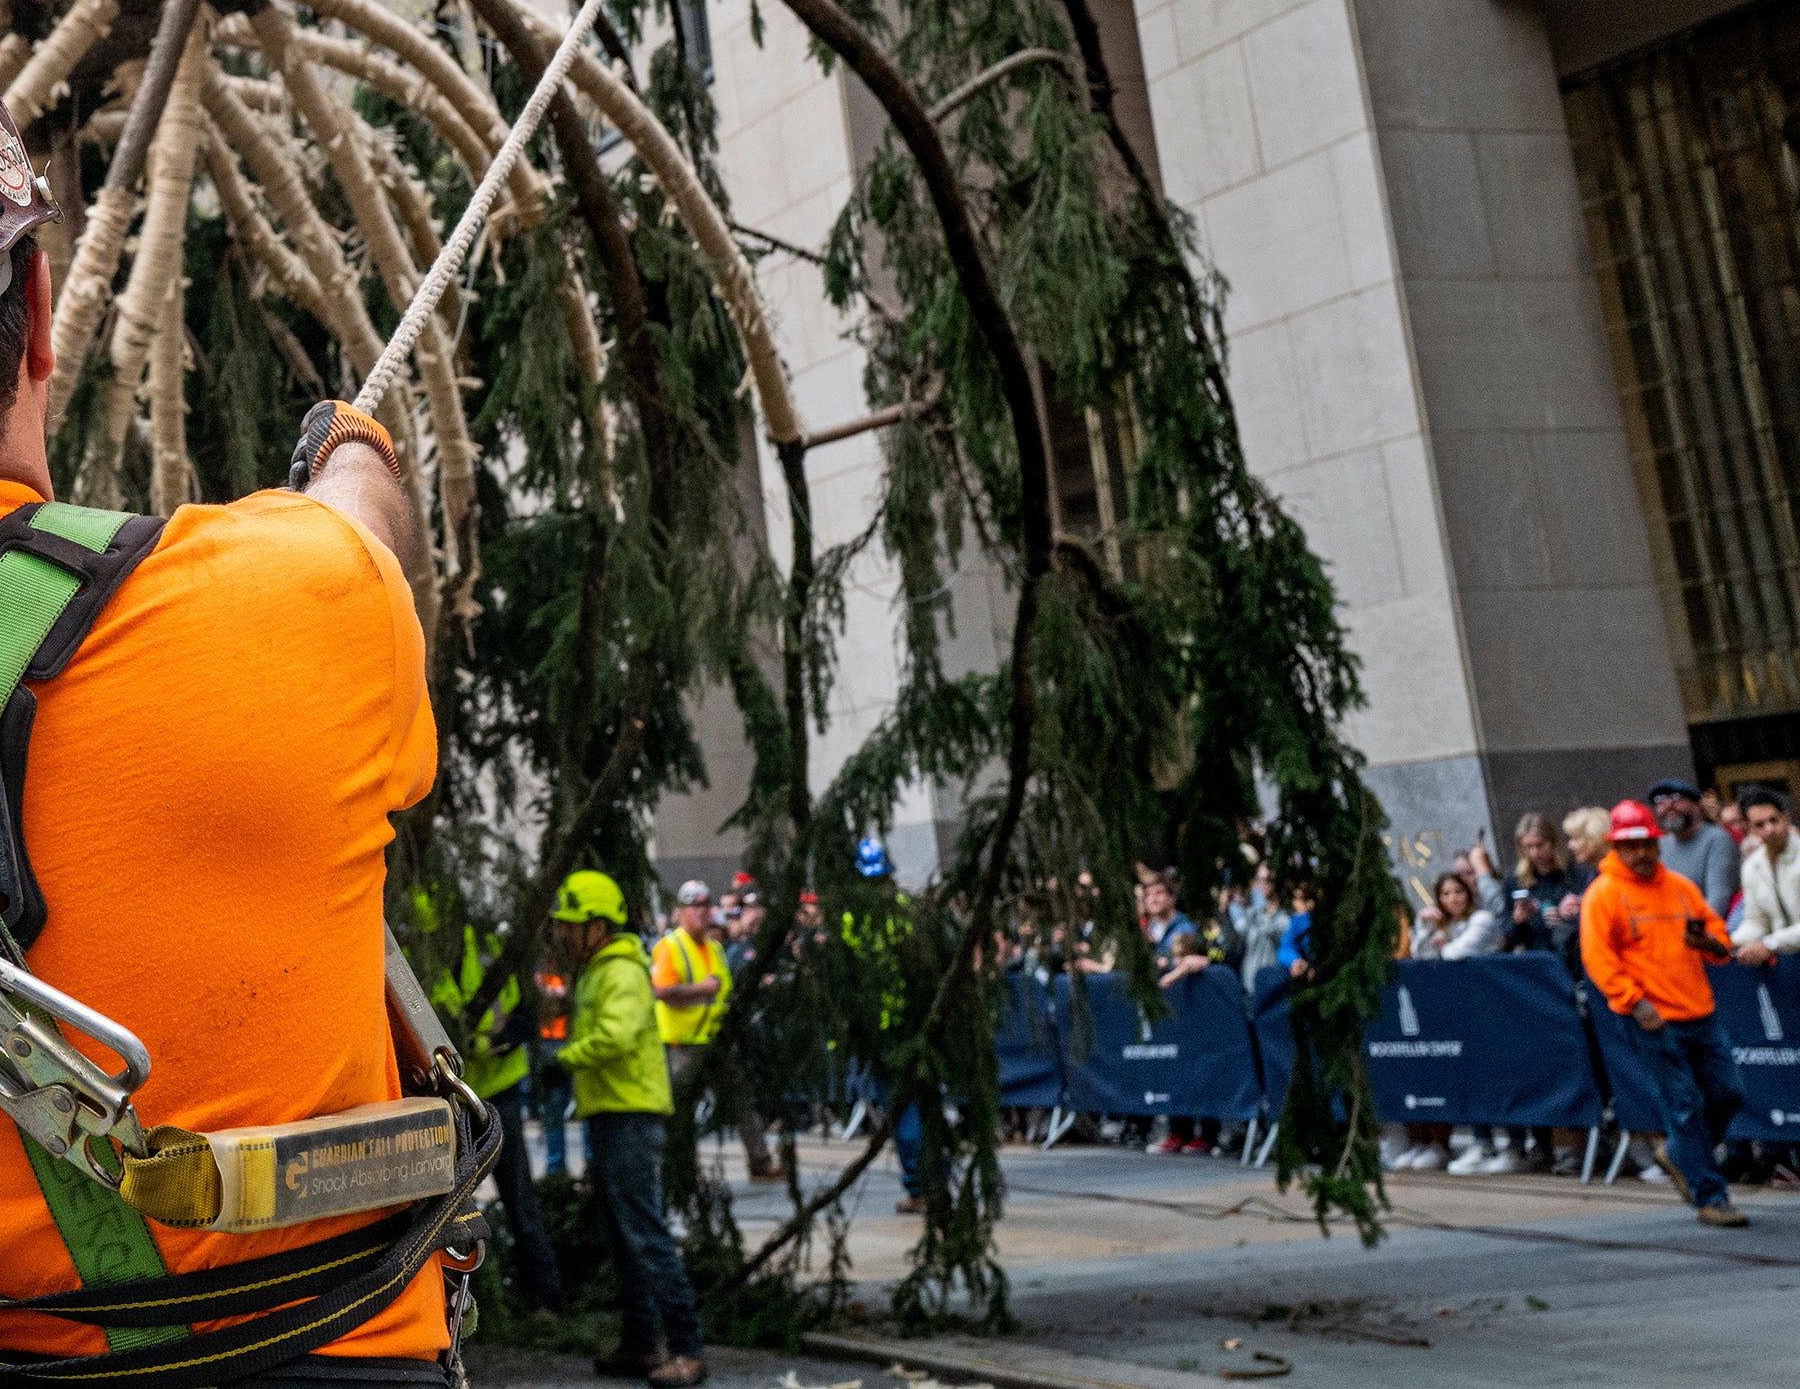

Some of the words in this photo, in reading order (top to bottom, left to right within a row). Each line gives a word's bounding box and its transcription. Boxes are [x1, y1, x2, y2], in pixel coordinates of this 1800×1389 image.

[312, 1139, 366, 1170] GUARDIAN
[369, 1136, 392, 1159] FALL
[395, 1124, 449, 1154] PROTECTION
[312, 1173, 349, 1196] Shock
[350, 1163, 409, 1188] Absorbing
[410, 1154, 451, 1177] Lanyard
